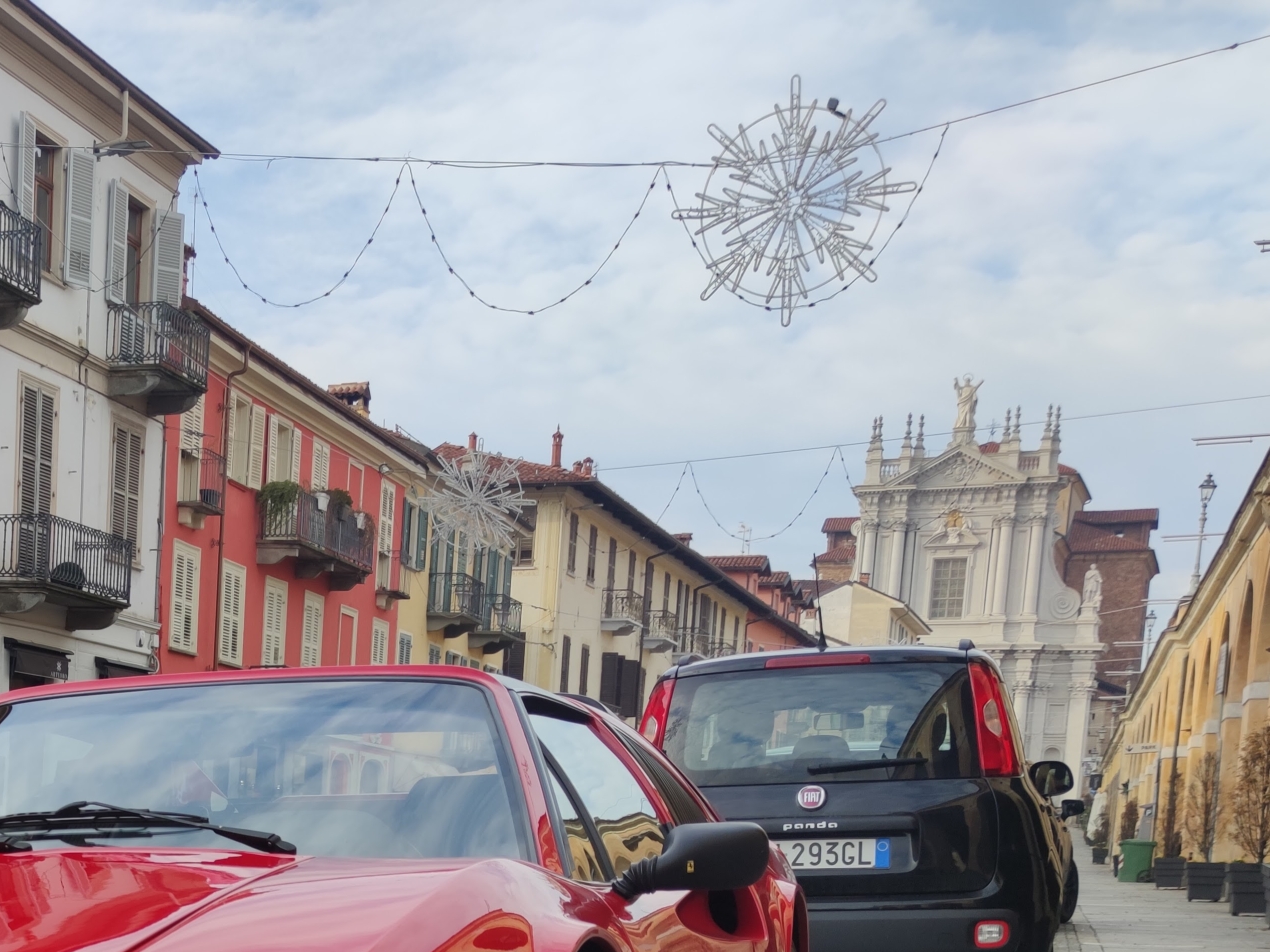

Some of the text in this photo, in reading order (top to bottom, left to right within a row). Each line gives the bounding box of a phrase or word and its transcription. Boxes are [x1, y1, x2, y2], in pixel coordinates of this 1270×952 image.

[804, 791, 820, 803] FIAT
[782, 821, 838, 831] panda
[791, 841, 872, 867] 293GL
